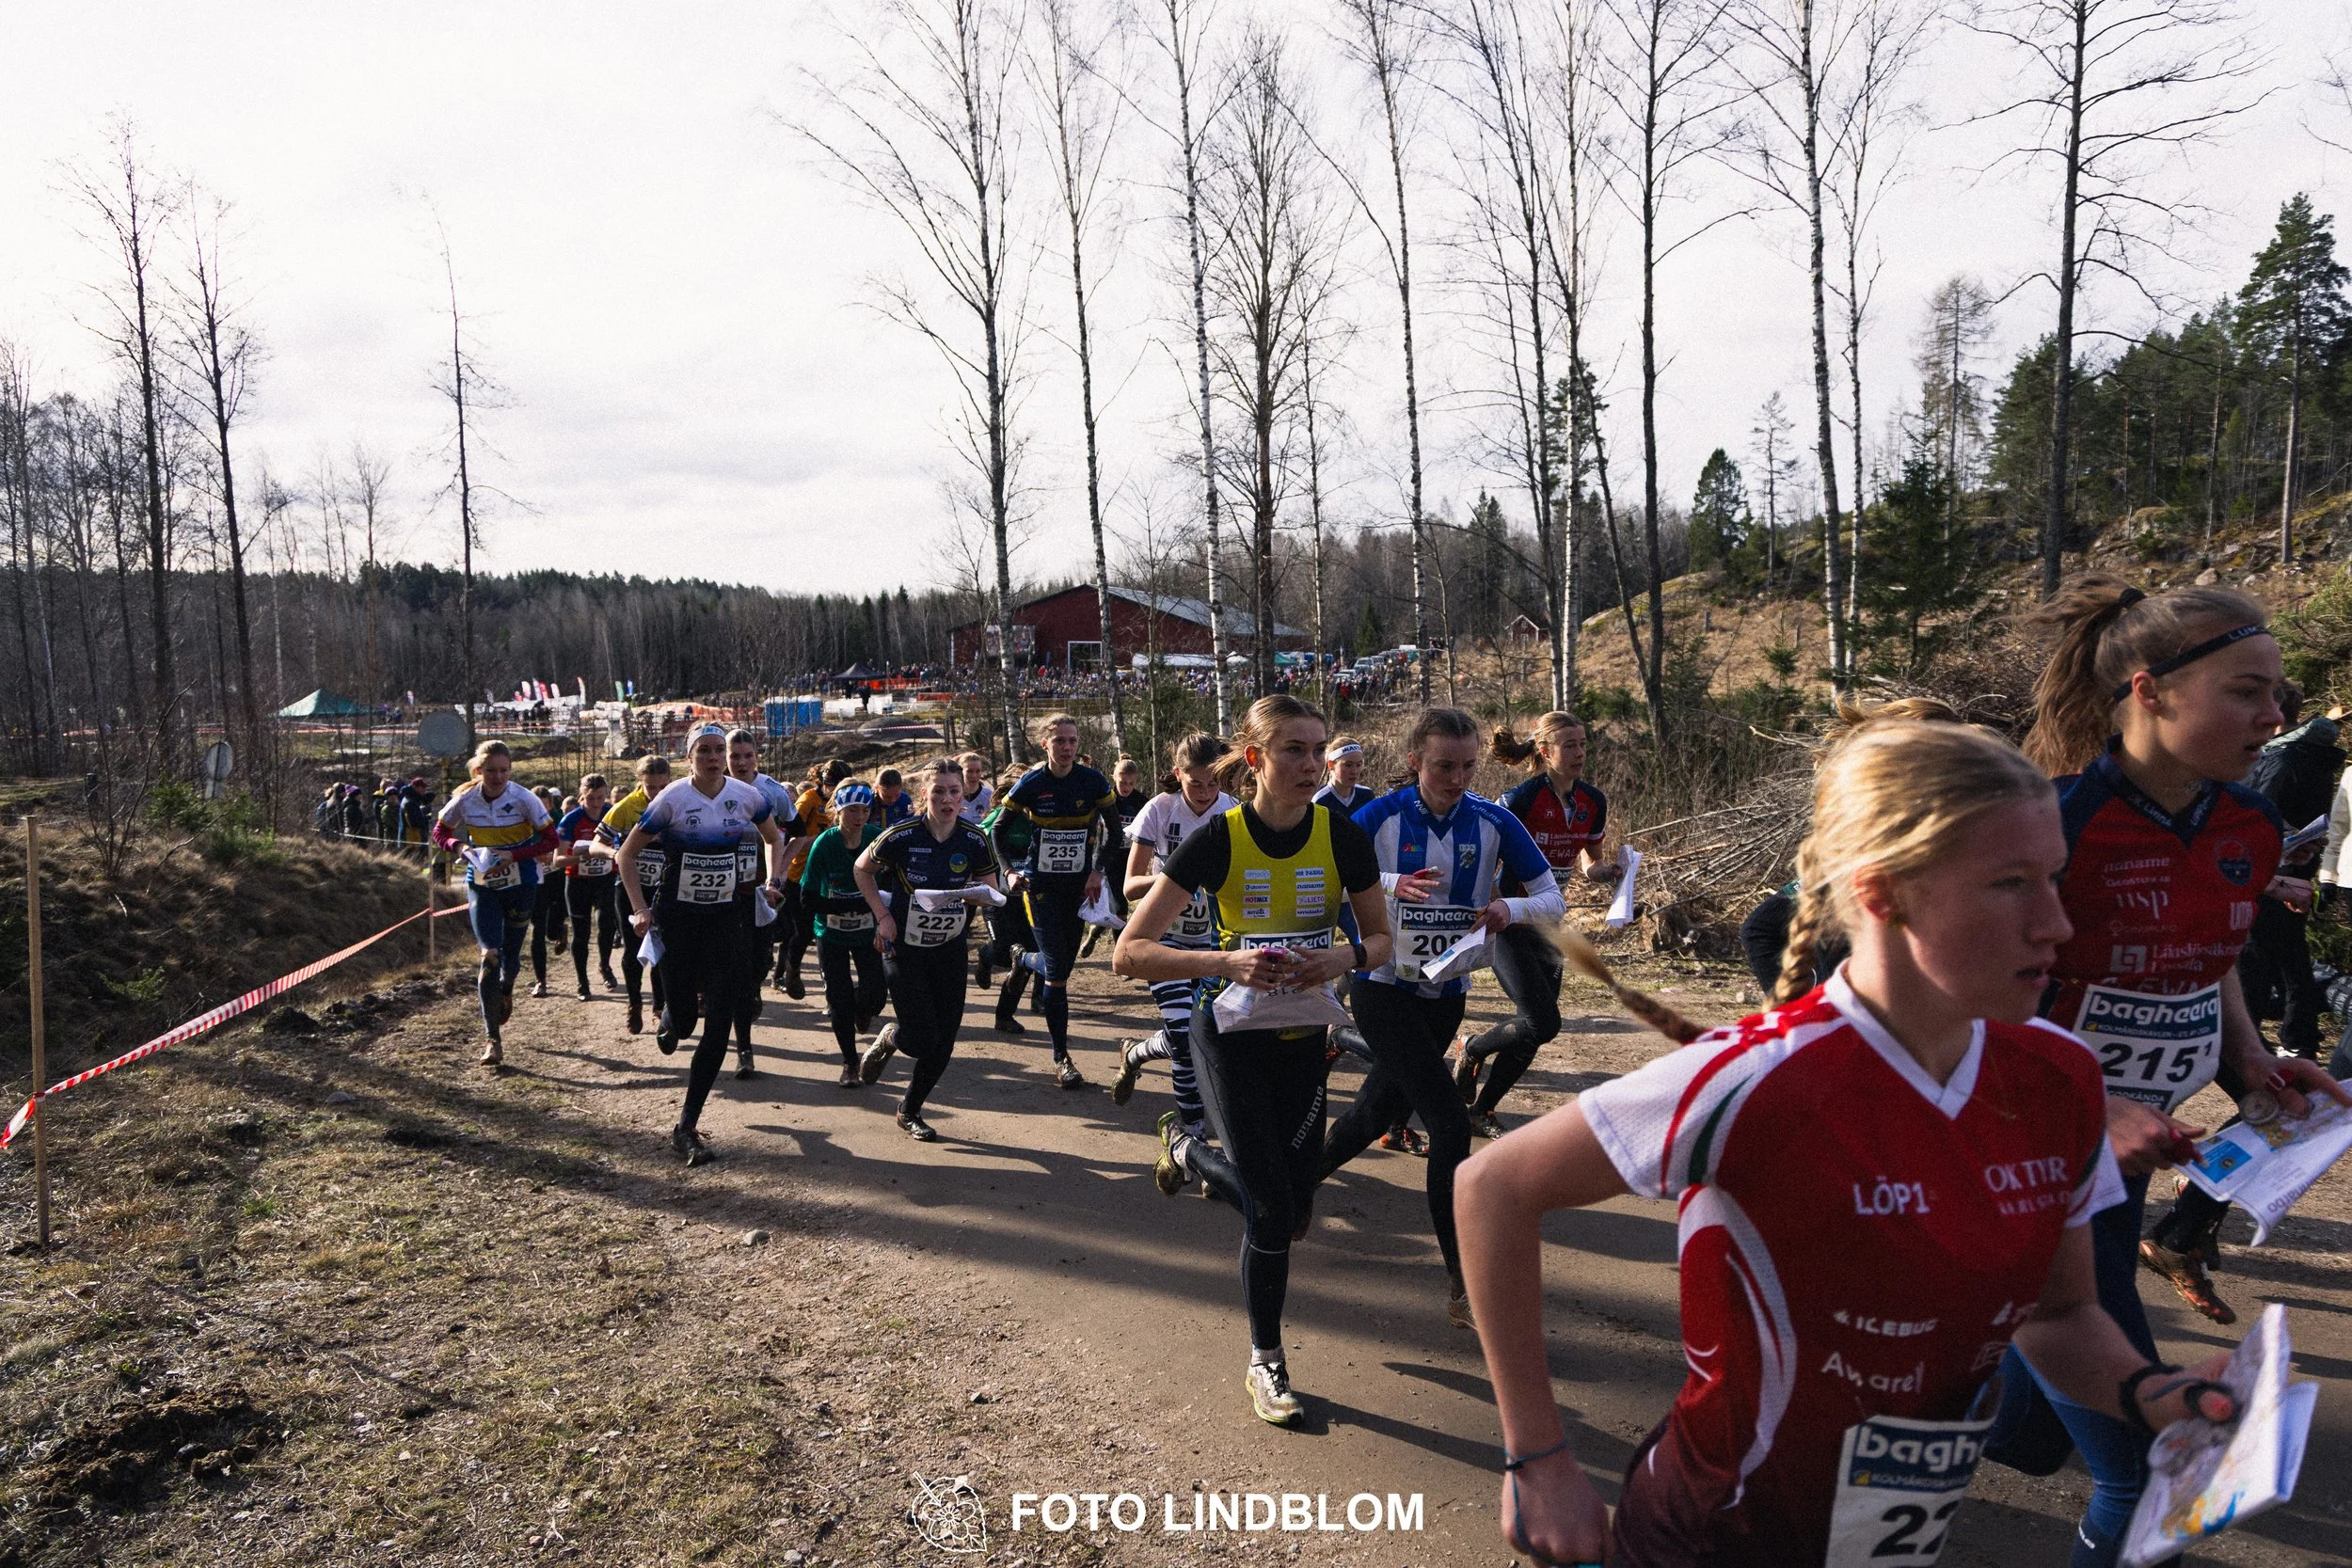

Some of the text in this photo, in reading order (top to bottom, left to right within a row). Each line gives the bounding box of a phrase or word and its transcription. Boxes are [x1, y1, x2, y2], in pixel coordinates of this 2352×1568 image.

[1048, 847, 1078, 858] 235
[685, 856, 734, 867] bagheera
[690, 873, 726, 887] 232
[907, 873, 928, 881] coop
[916, 915, 954, 930] 222
[1402, 907, 1476, 924] bagheera
[2089, 994, 2218, 1025] bagheera
[2099, 1041, 2213, 1084] 215 1
[1290, 1085, 1324, 1150] noname
[1983, 1156, 2069, 1193] OK TYR
[1852, 1174, 1931, 1216] LÖP1
